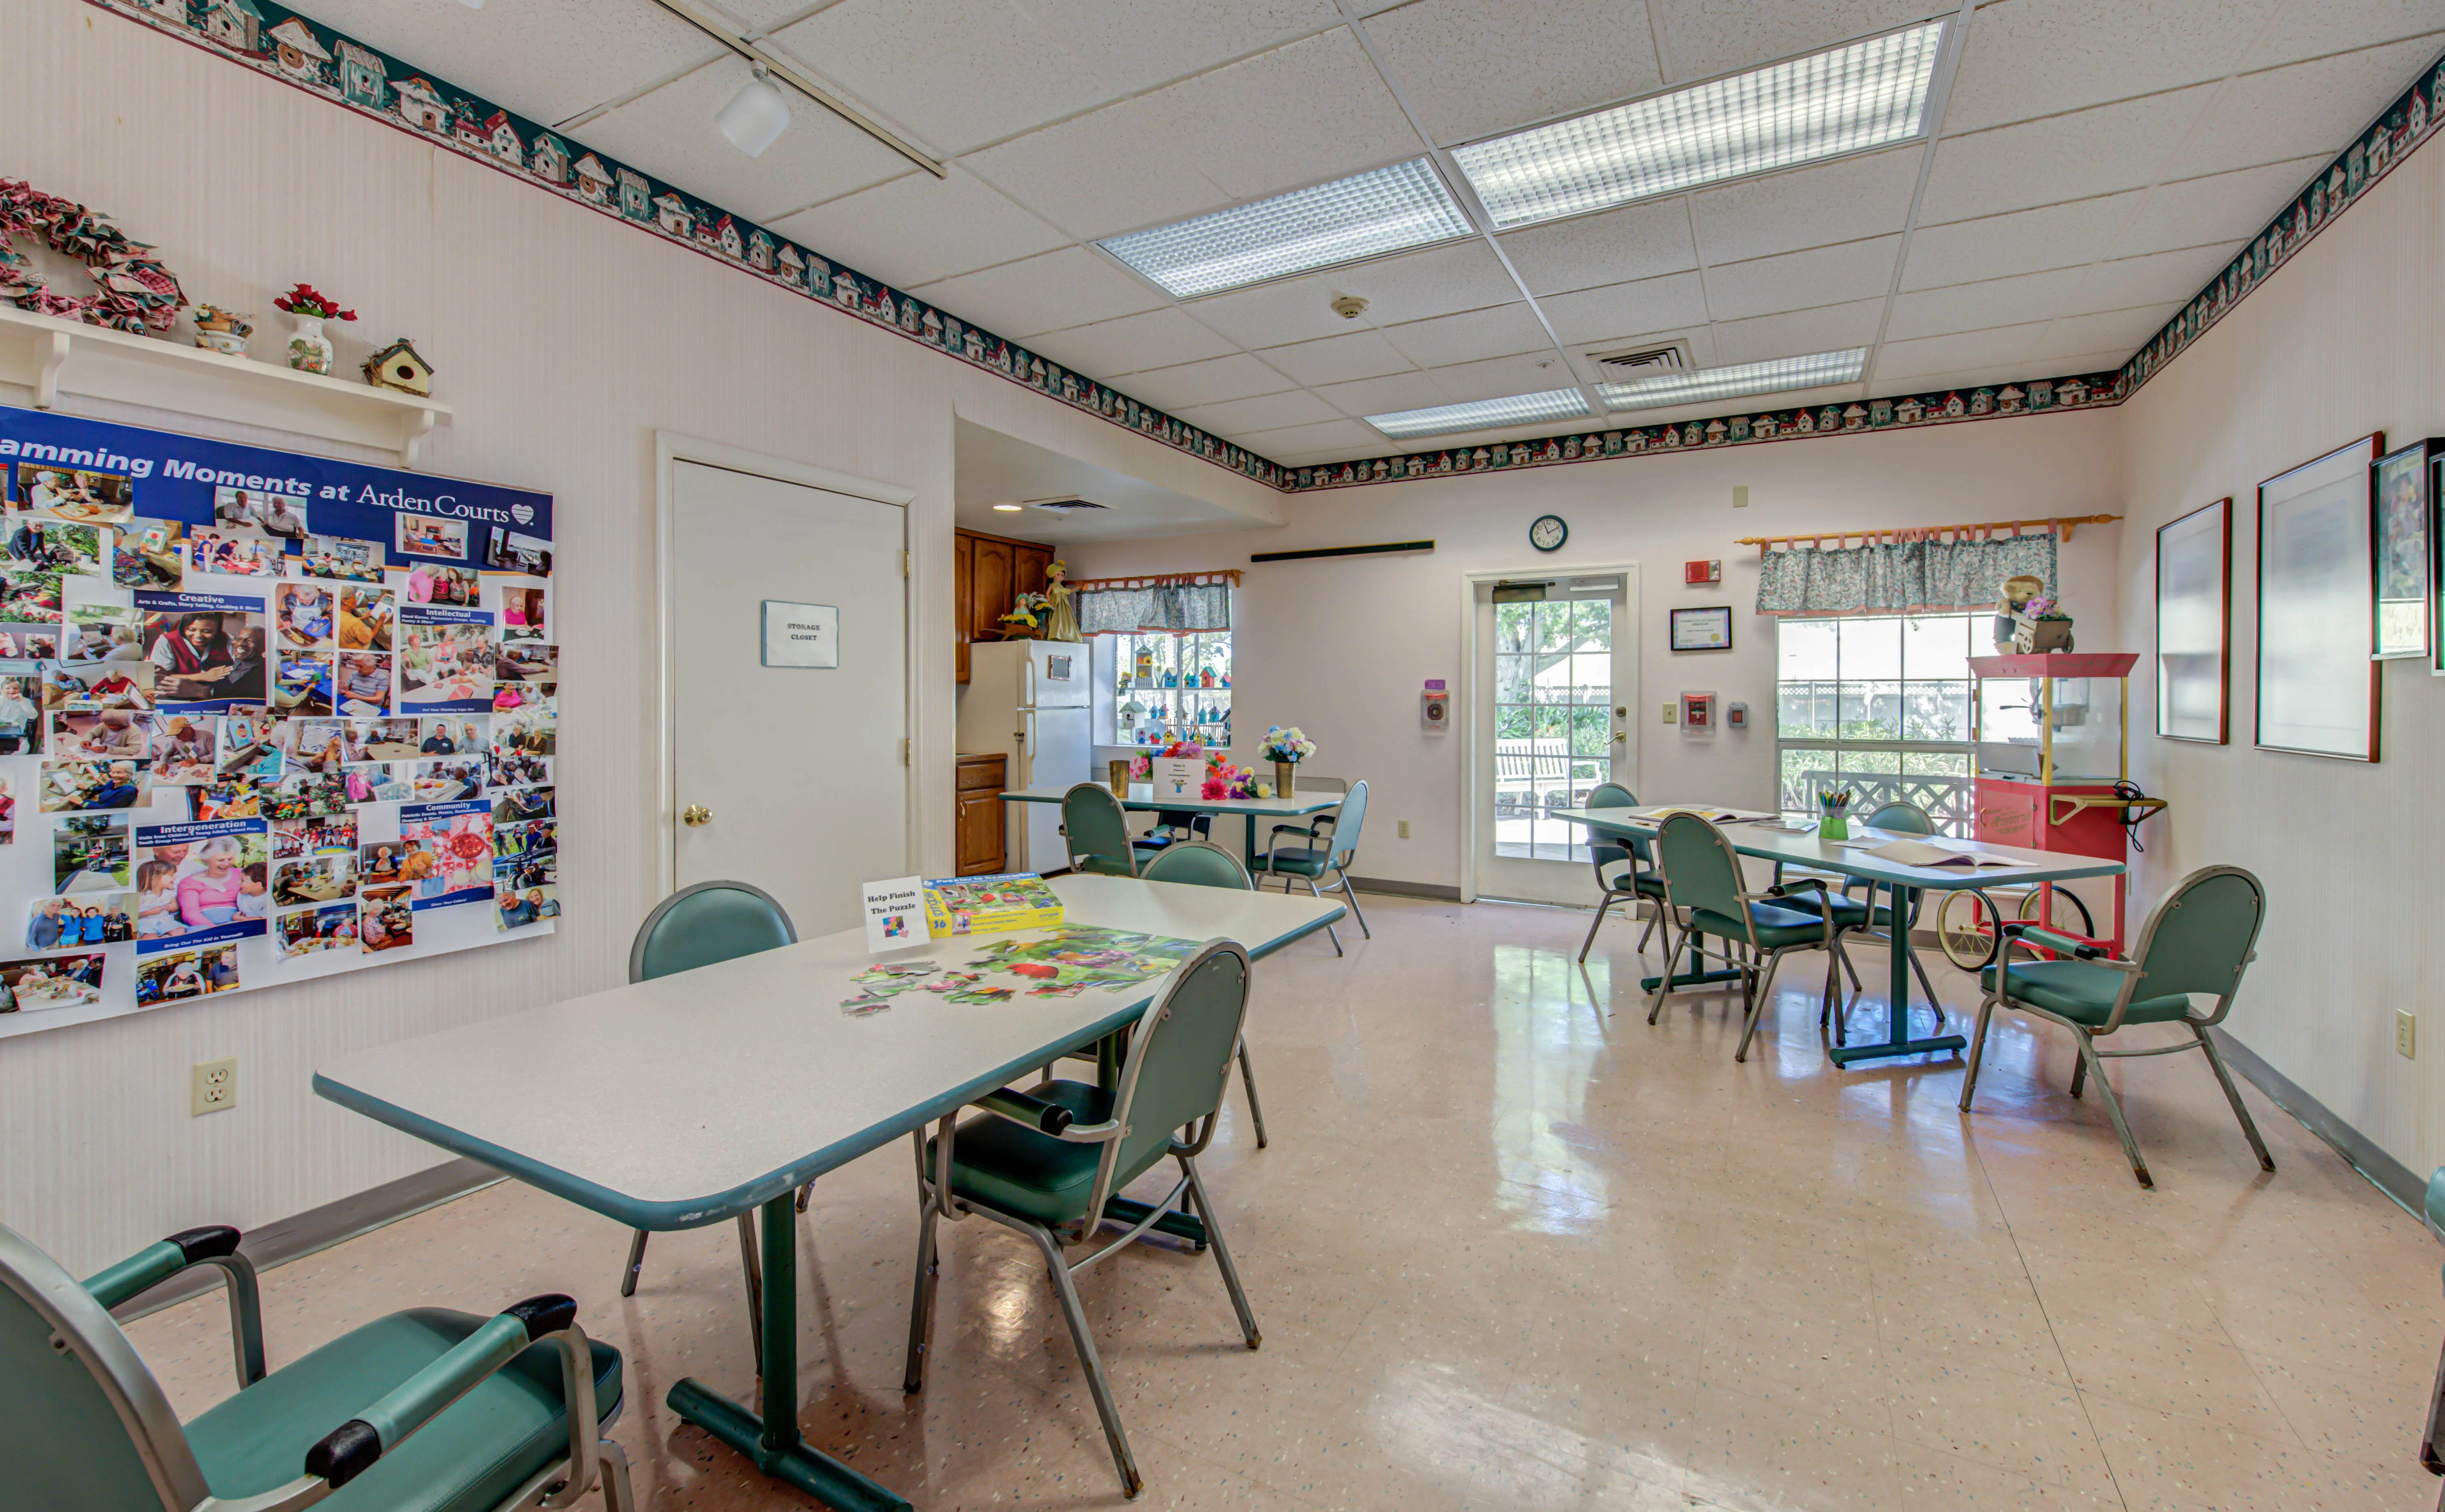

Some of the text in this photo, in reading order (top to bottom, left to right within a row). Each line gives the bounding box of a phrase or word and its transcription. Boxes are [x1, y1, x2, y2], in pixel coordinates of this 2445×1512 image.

[163, 459, 312, 496] Moments
[320, 485, 350, 502] at
[356, 484, 432, 513] Arden
[434, 495, 509, 524] Courts
[178, 593, 224, 604] Creative
[426, 609, 471, 618] Intellectual
[426, 802, 471, 811] Community
[160, 820, 247, 834] Intergeneration
[889, 891, 915, 900] Finish
[889, 903, 916, 912] Puzzle
[934, 919, 947, 929] 36
